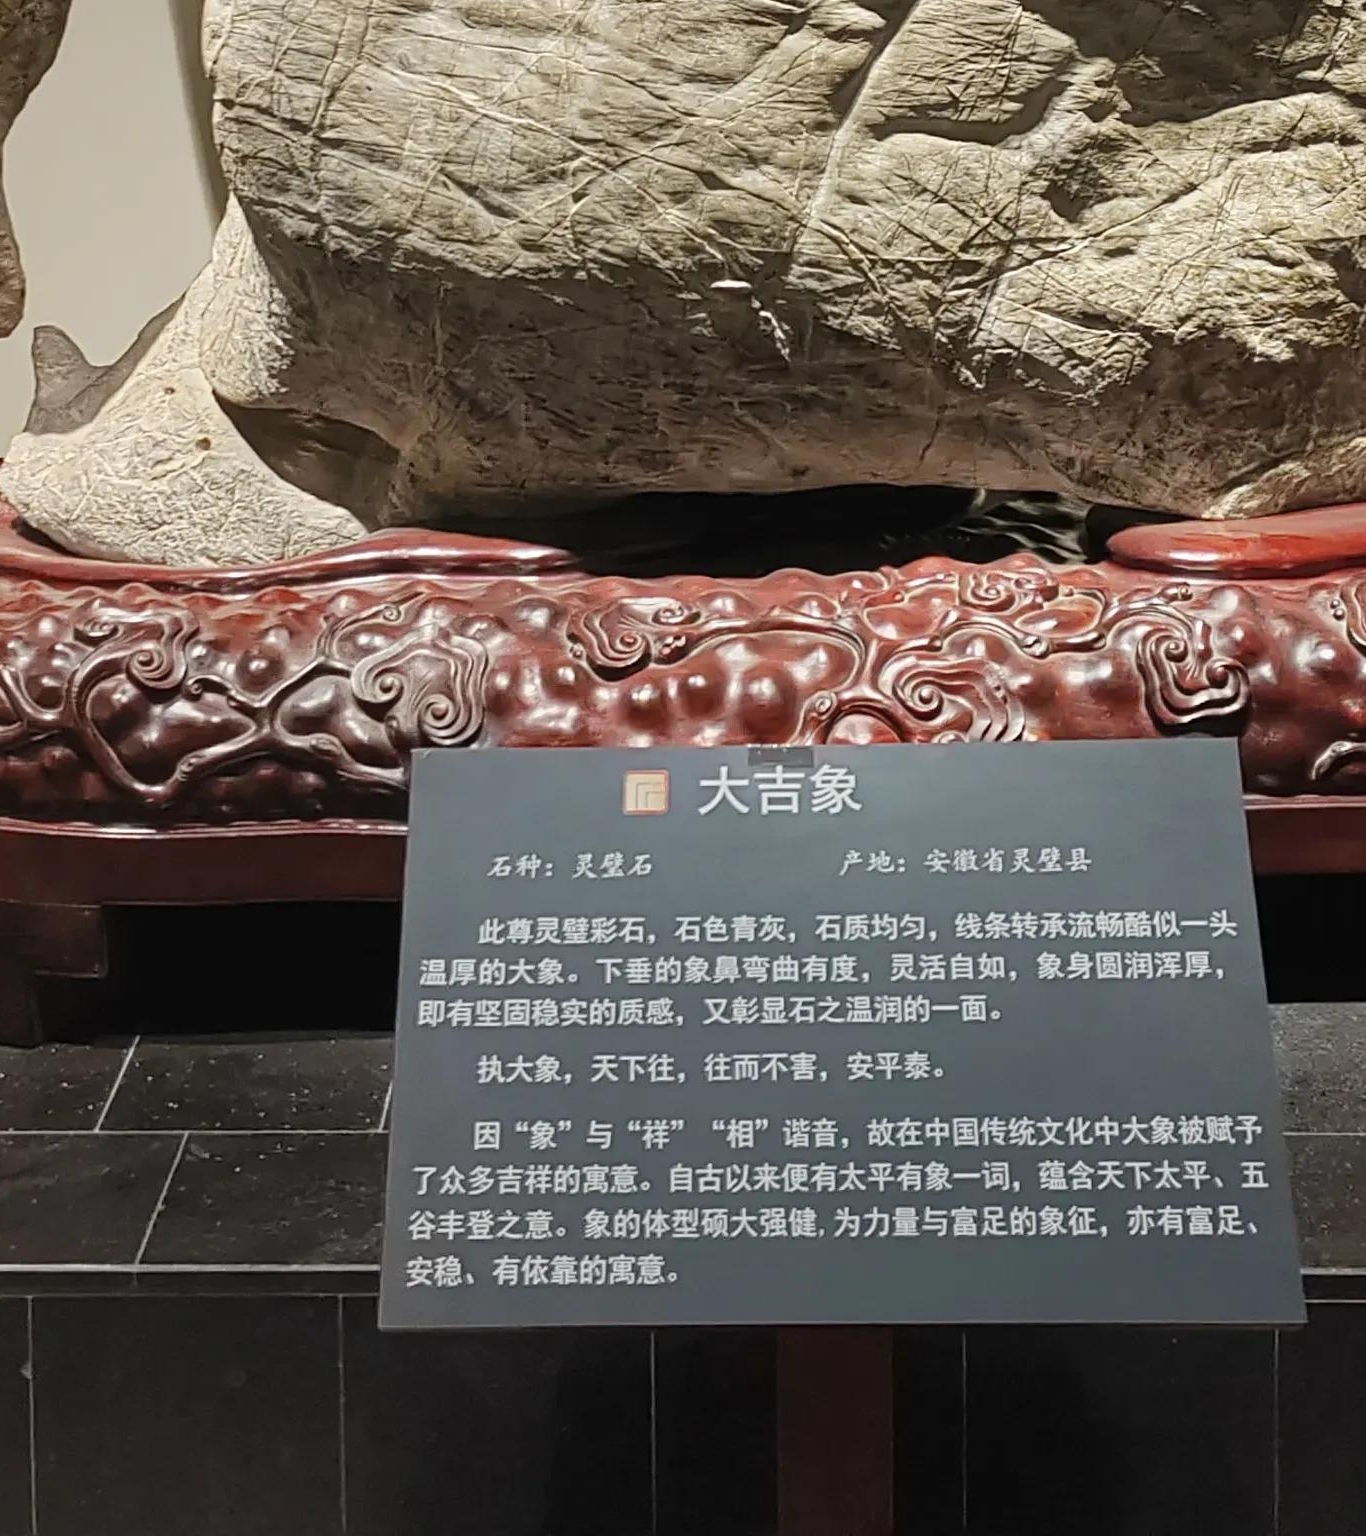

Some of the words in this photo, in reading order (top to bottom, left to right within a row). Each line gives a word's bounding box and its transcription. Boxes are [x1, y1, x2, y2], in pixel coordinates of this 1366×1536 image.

[697, 764, 863, 816] 大吉象
[418, 950, 1225, 987] 温厚的大象。下垂的象鼻弯曲有度，灵活自如，象身圆润浑厚，
[416, 993, 1003, 1028] 即有坚固稳实的质感，又彰显石之温润的一面。
[476, 1050, 945, 1085] 执大象，天下往，往而不害，安平泰。
[412, 1159, 1270, 1196] 了众多吉祥的寓意。自古以来便有太平有象一词，蕴含天下太平、五
[405, 1252, 678, 1288] 安稳、有依靠的寓意。
